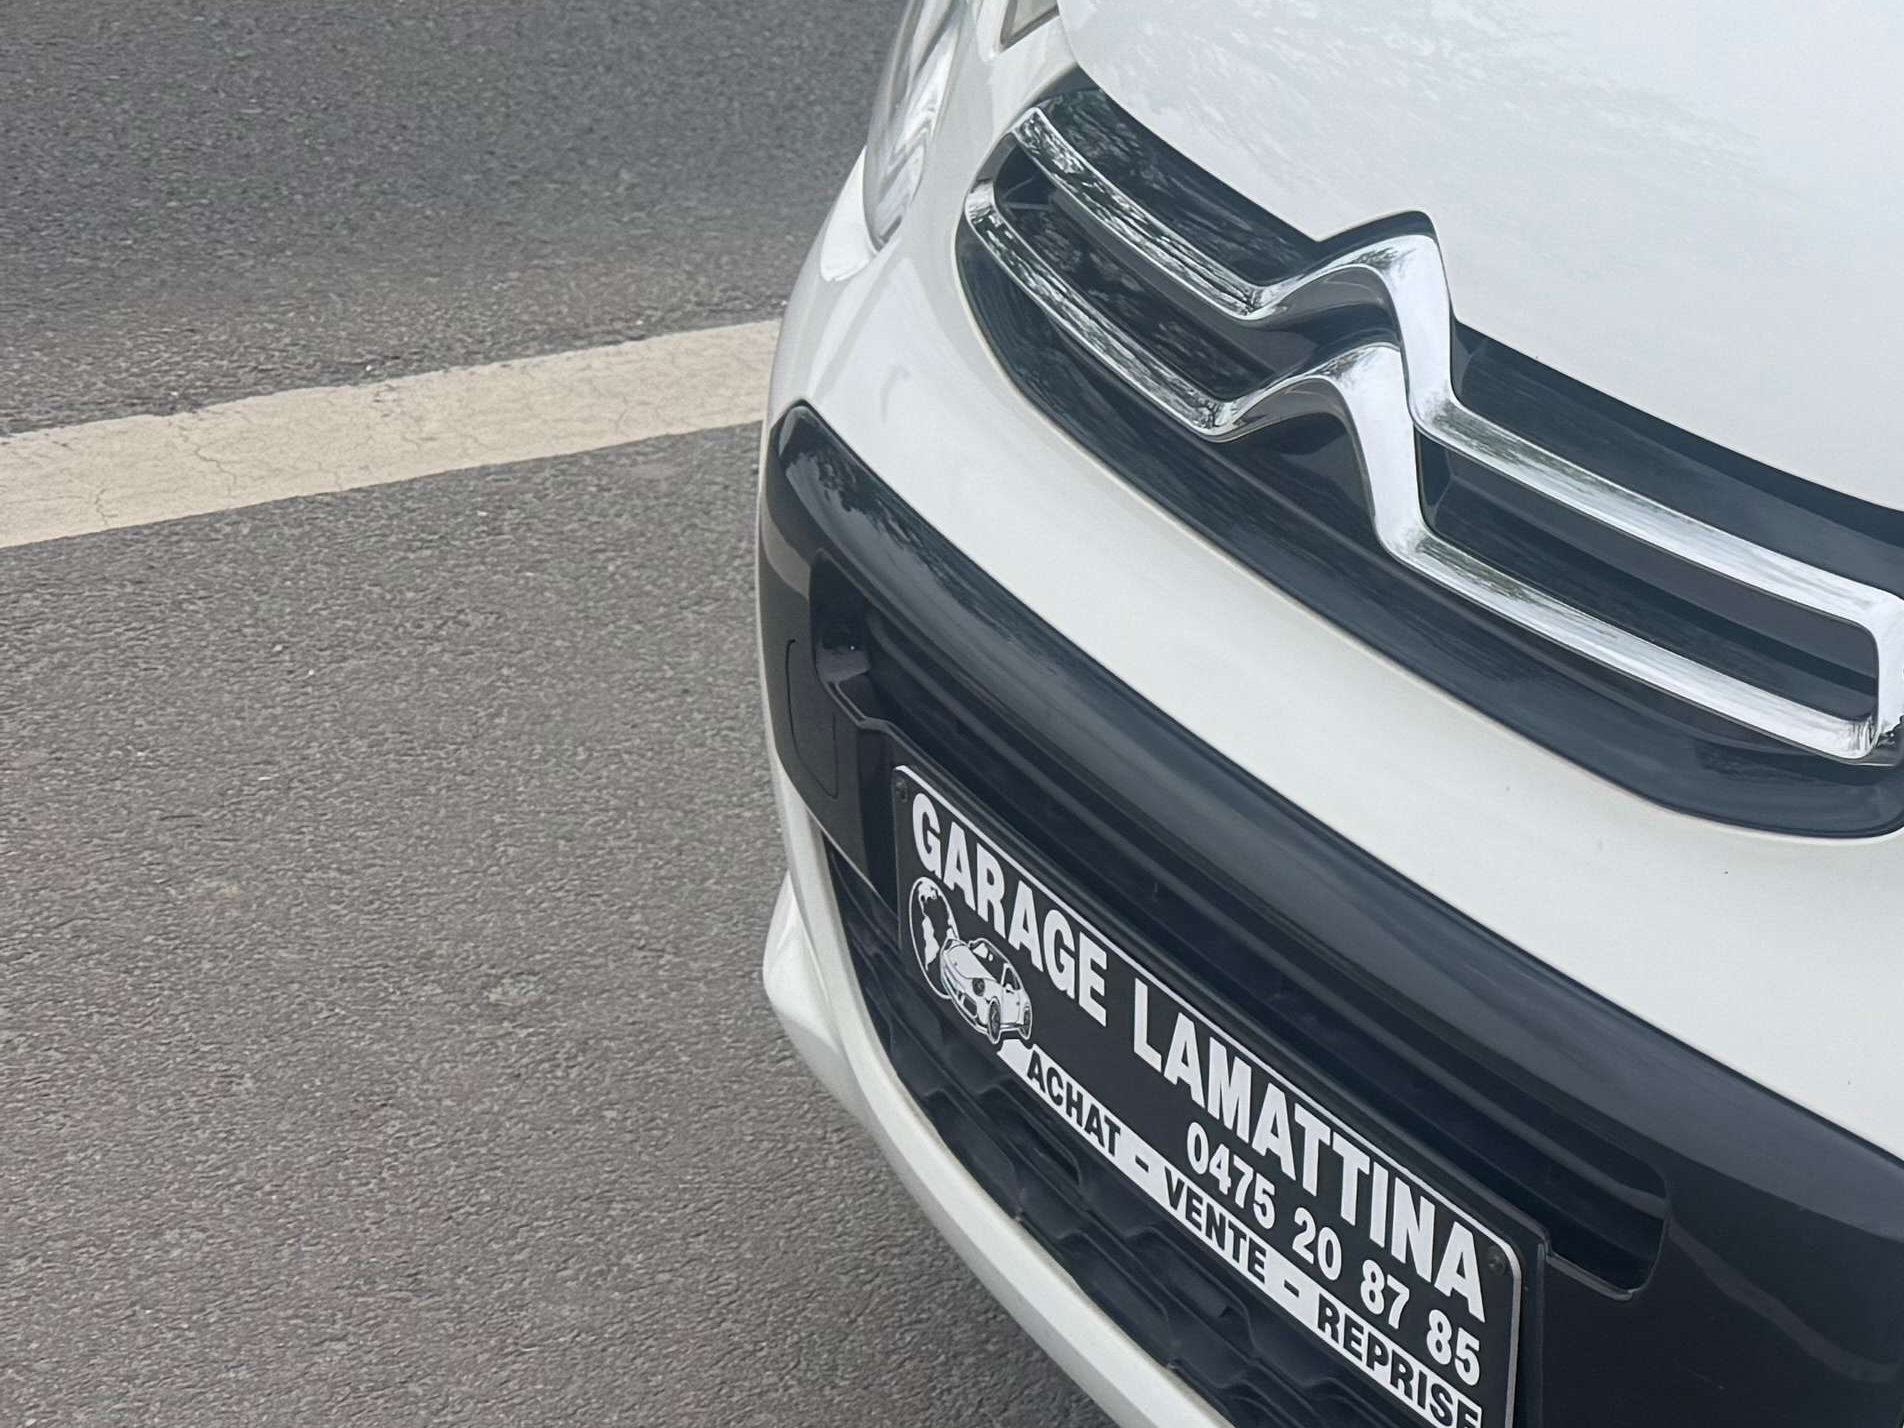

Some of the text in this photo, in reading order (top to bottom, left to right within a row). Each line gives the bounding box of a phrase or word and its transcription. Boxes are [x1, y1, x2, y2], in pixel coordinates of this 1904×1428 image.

[912, 793, 1486, 1324] GARAGE LAMATTINA
[1026, 1050, 1121, 1158] ACHAT
[1164, 1165, 1267, 1285] VENTE
[1186, 1121, 1480, 1387] 0475 20 87 85
